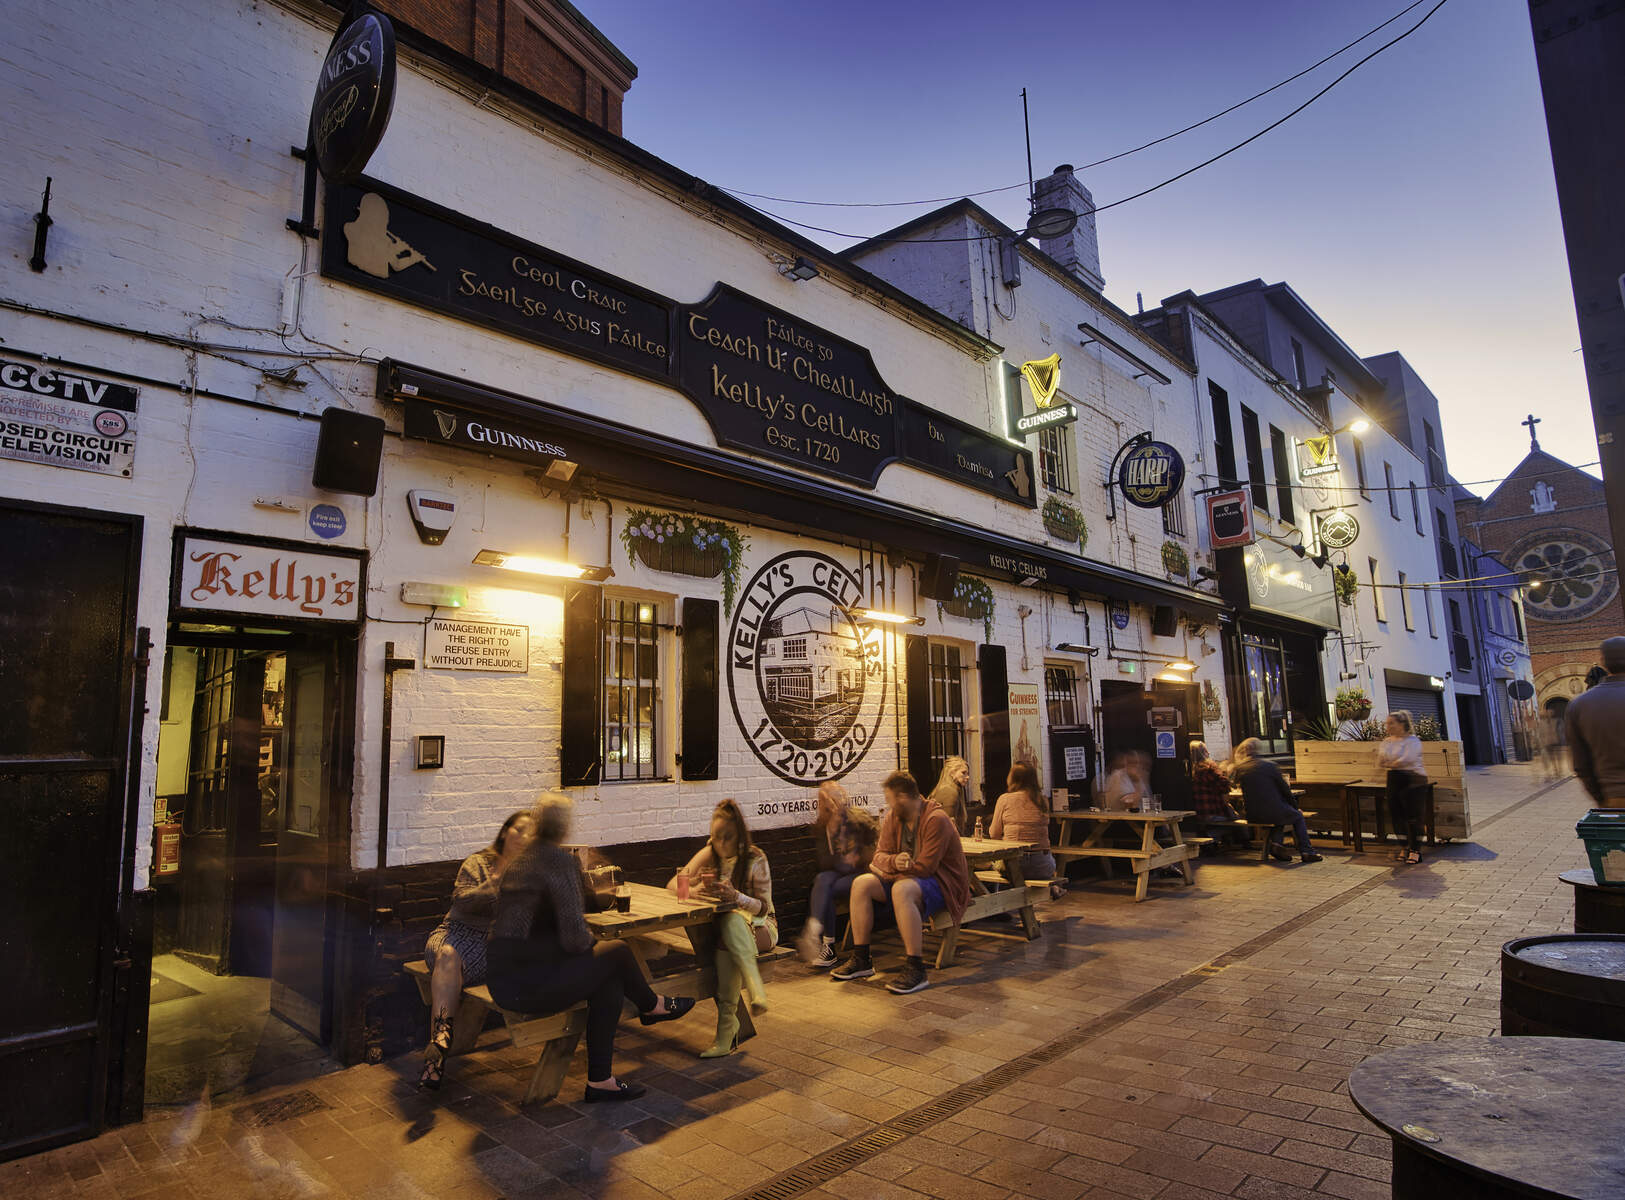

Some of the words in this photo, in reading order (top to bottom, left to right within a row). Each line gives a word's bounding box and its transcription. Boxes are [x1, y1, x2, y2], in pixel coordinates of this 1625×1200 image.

[512, 256, 565, 292] Ceol
[688, 311, 761, 361] Teach
[1, 365, 109, 404] CCTV
[711, 363, 796, 421] Kelly's
[0, 405, 54, 422] OTECTED
[57, 416, 72, 425] BY
[69, 407, 90, 419] ARE
[1017, 406, 1068, 430] GUINNESS
[0, 436, 111, 465] ELEVISION
[51, 431, 133, 454] CIRCUIT
[466, 422, 567, 457] GUINNESS
[805, 437, 841, 464] 1720
[1128, 458, 1168, 485] HARP
[989, 553, 1017, 572] KELLY'S
[1018, 561, 1048, 580] CELLARS
[190, 551, 356, 616] Kelly's
[434, 622, 497, 635] MANAGEMENT
[500, 628, 521, 637] HAVE
[734, 563, 794, 671] KELLY'S
[444, 645, 480, 656] REFUSE
[482, 647, 511, 657] ENTRY
[448, 634, 466, 644] THE
[468, 636, 495, 646] RIGHT
[498, 638, 509, 647] TO
[431, 655, 475, 666] WITHOUT
[476, 658, 523, 669] PREJUDICE
[1010, 692, 1037, 704] GUINNESS
[757, 803, 779, 815] 300
[781, 800, 810, 813] YEARS
